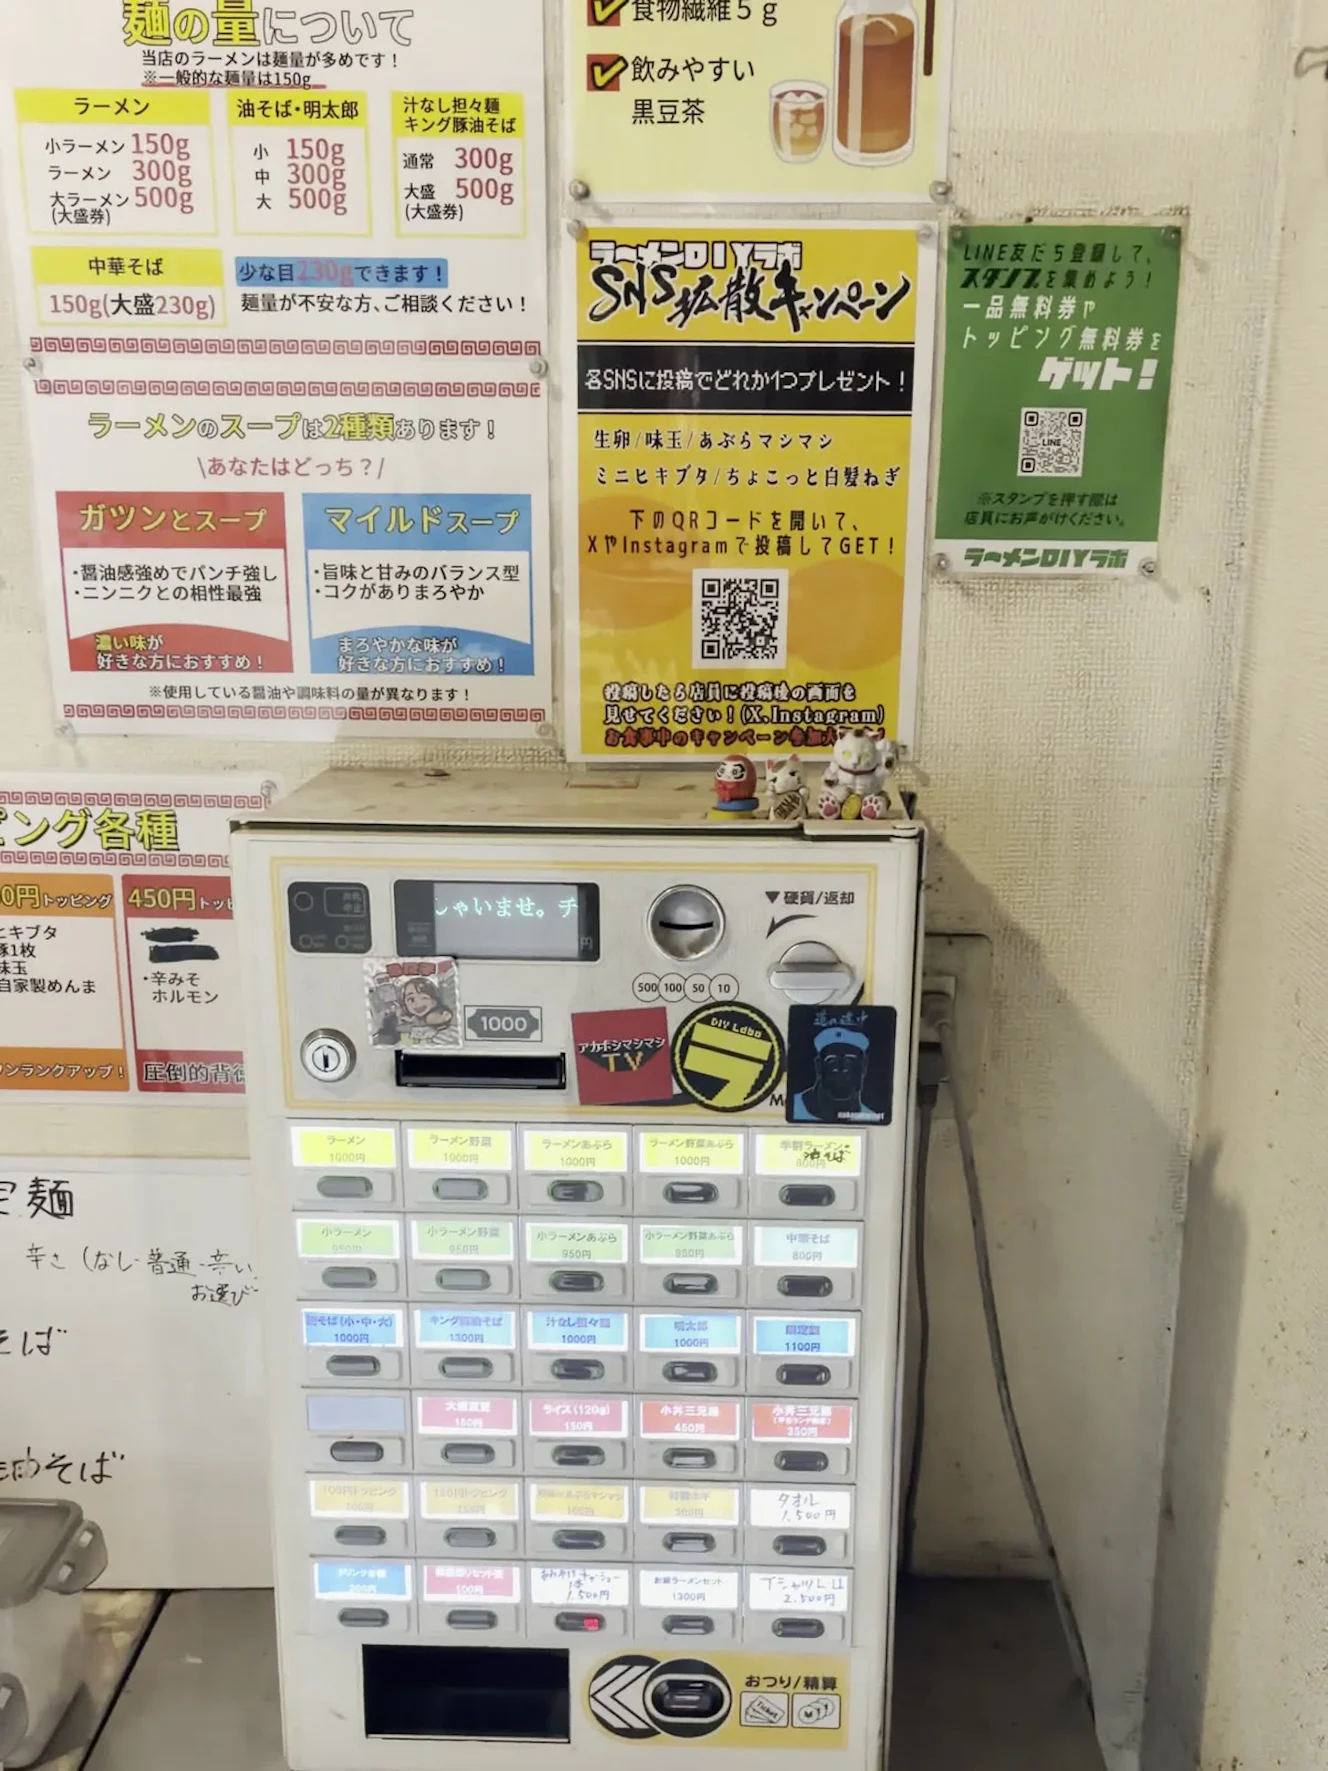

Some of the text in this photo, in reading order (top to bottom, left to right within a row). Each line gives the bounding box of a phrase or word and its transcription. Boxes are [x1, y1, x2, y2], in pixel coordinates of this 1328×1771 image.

[122, 0, 414, 46] 麺の量について
[142, 49, 398, 68] 当店のラーメンは麺量が多めです！
[143, 69, 312, 89] ※一般的な麺量は150g
[631, 56, 755, 83] 飲みやすい
[73, 97, 150, 116] ラーメン
[236, 98, 360, 120] 油そば・明太郎
[403, 97, 500, 115] 汁なし担々麺
[631, 98, 706, 125] 黒豆茶
[403, 116, 517, 134] キング豚油そば
[45, 132, 191, 162] 小ラーメン 150g
[252, 138, 345, 166] 小 150g
[402, 147, 514, 176] 通常 300g
[47, 159, 193, 188] ラーメン 300g
[255, 162, 346, 192] 中 300g
[50, 186, 194, 215] 大ラーメン 500g
[256, 187, 348, 216] 大 500g
[404, 177, 515, 206] 大盛 500g
[51, 207, 111, 227] (大盛券)
[405, 203, 464, 222] (大盛券)
[88, 256, 164, 276] 中華そば
[238, 258, 443, 287] 少な目230gできます！
[240, 292, 527, 315] 麺量が不安な方、ご相談ください！
[963, 294, 1096, 320] 一品無料券や
[962, 325, 1162, 352] トッピング無料券を
[87, 411, 496, 442] ラーメンのスープは2種類あります！
[1042, 438, 1062, 447] LINE
[79, 503, 268, 532] ガツンとスープ
[324, 505, 521, 535] マイルドスープ
[629, 509, 859, 532] 下のQRコードを開いて、
[964, 547, 1130, 569] ラーメンDIYラボ
[338, 637, 458, 654] まろやかな味が
[96, 653, 265, 673] 好きな方におすすめ！
[337, 655, 505, 674] 好きな方におすすめ！
[603, 681, 857, 702] 投稿したら店員に投稿後の画面を
[0, 808, 180, 852] ング各種
[152, 990, 219, 1004] ホルモン
[637, 982, 731, 994] 500 100 50 10
[480, 1014, 528, 1033] 1000
[0, 1063, 125, 1079] ンランクアップ！
[601, 1051, 645, 1072] TV
[327, 1135, 366, 1146] ラーメン
[329, 1153, 366, 1163] 1000円
[443, 1153, 479, 1164] 1000円
[560, 1156, 596, 1167] 1000円
[675, 1155, 711, 1166] 1000円
[321, 1226, 372, 1237] 小ラーメン
[334, 1333, 370, 1344] 1000円
[561, 1334, 597, 1345] 1000円
[674, 1338, 709, 1348] 1000円
[785, 1342, 821, 1352] 1100円
[674, 1422, 706, 1433] 450円
